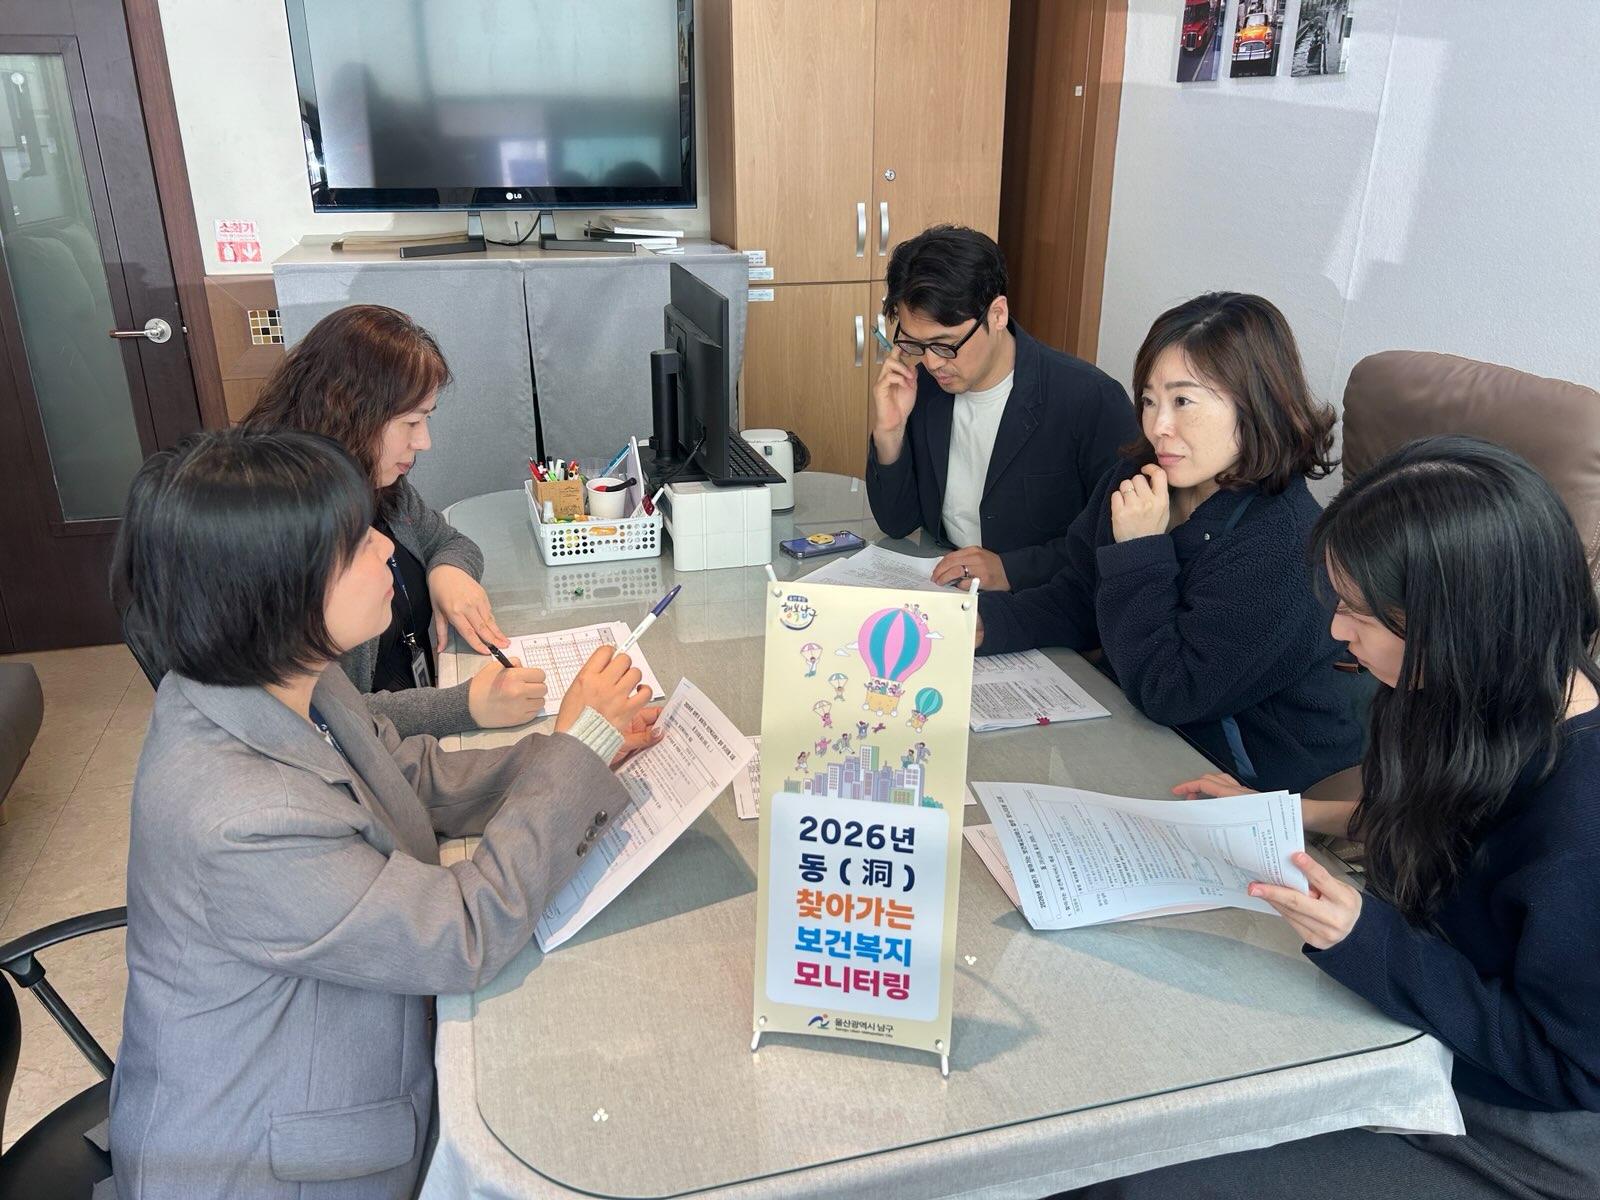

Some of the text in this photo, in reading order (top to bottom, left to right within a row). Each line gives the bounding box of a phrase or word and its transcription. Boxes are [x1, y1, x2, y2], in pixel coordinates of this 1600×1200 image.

[219, 222, 254, 234] 소화기
[799, 815, 916, 854] 2026년
[796, 888, 915, 931] 찾아가는
[795, 926, 912, 968] 보건복지
[794, 961, 910, 1001] 모니터링
[835, 1018, 876, 1031] 울산광역시
[877, 1023, 894, 1032] 남구
